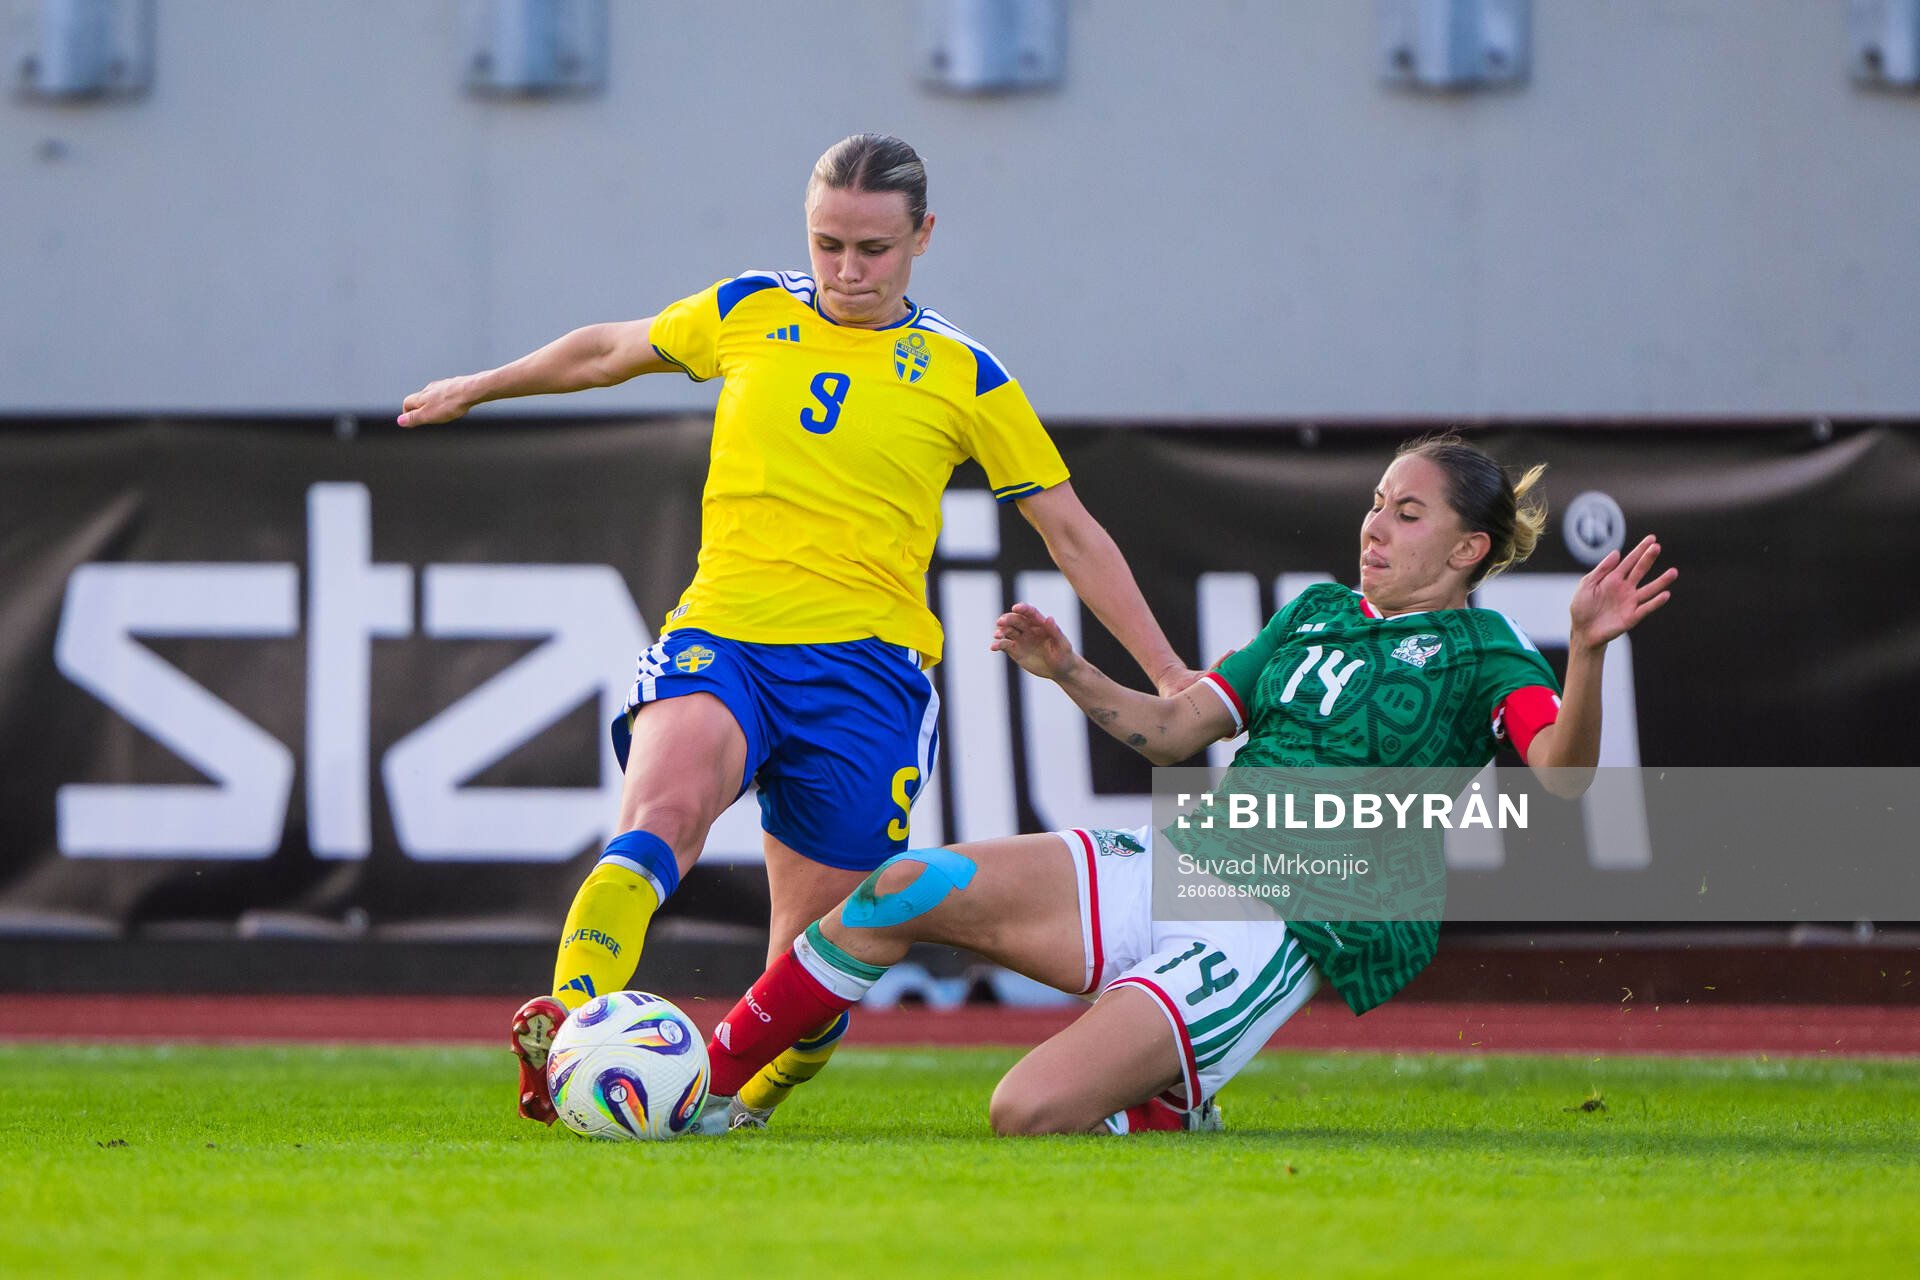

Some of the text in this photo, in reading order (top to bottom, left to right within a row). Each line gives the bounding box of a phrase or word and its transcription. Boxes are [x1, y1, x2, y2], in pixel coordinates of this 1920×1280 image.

[799, 372, 851, 435] 9
[1279, 645, 1365, 717] 14
[564, 929, 622, 959] SVERIGE
[1153, 941, 1240, 1006] 14
